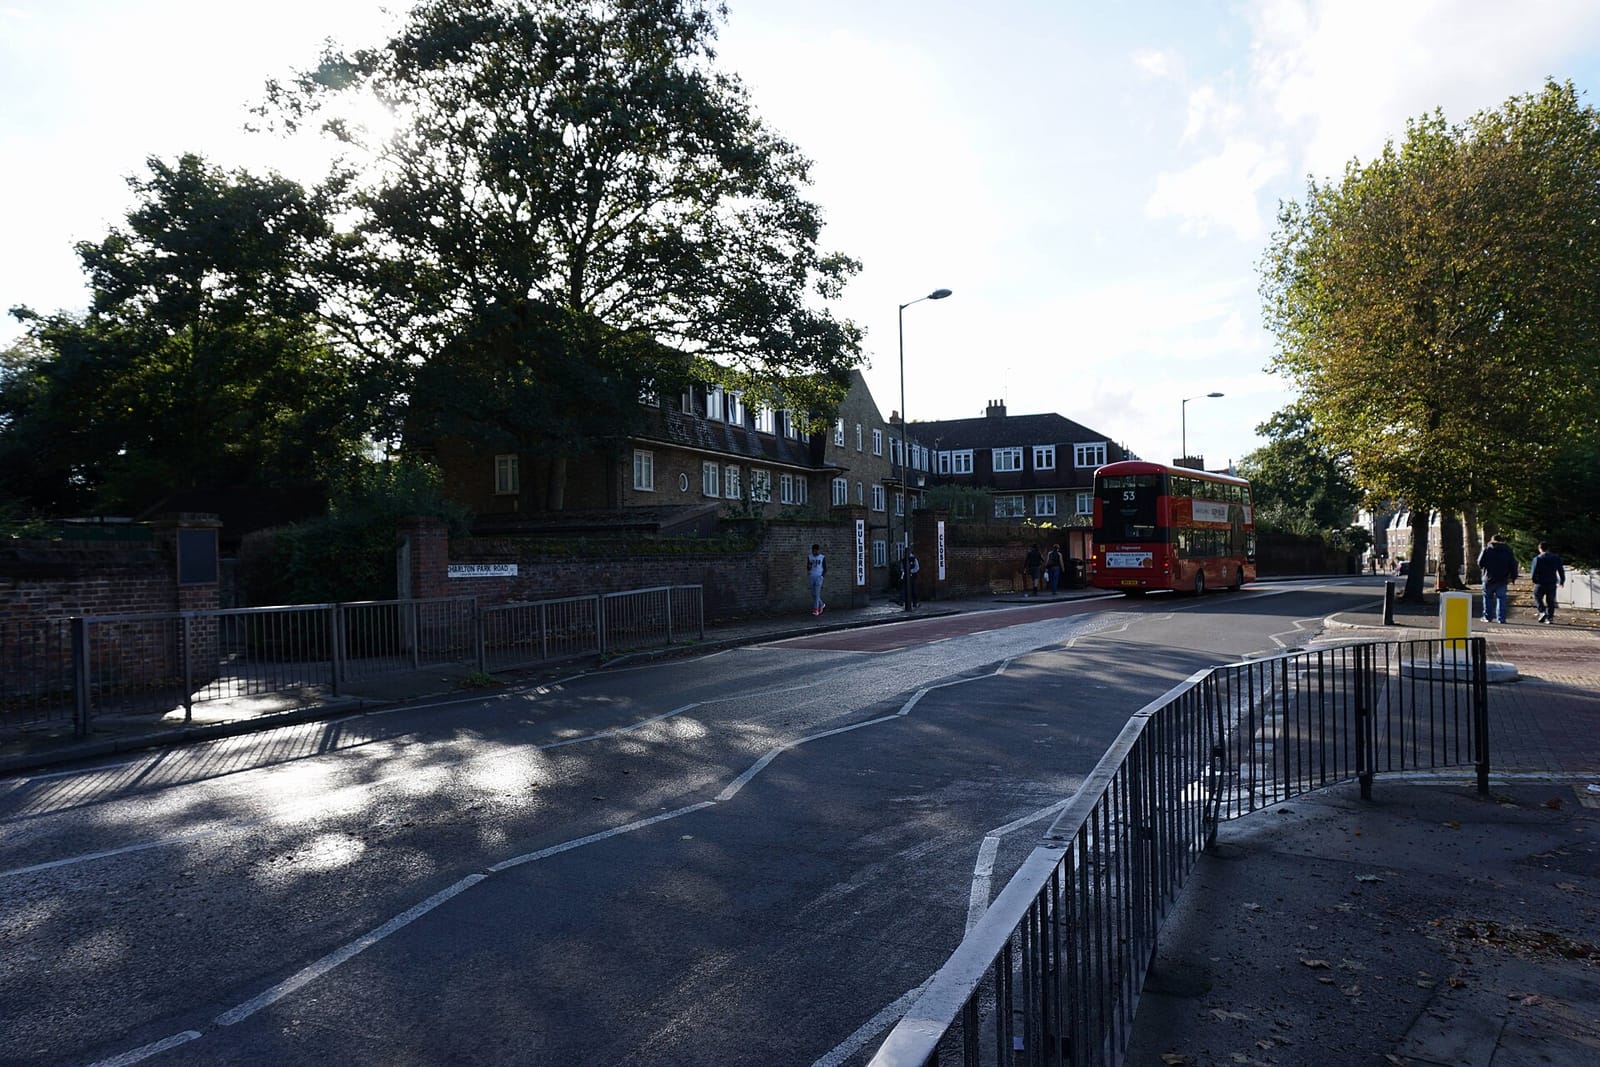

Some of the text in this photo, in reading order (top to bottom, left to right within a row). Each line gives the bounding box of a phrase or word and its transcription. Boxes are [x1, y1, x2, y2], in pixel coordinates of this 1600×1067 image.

[1123, 491, 1135, 501] 53
[477, 564, 491, 572] PARK
[494, 564, 508, 572] ROAD
